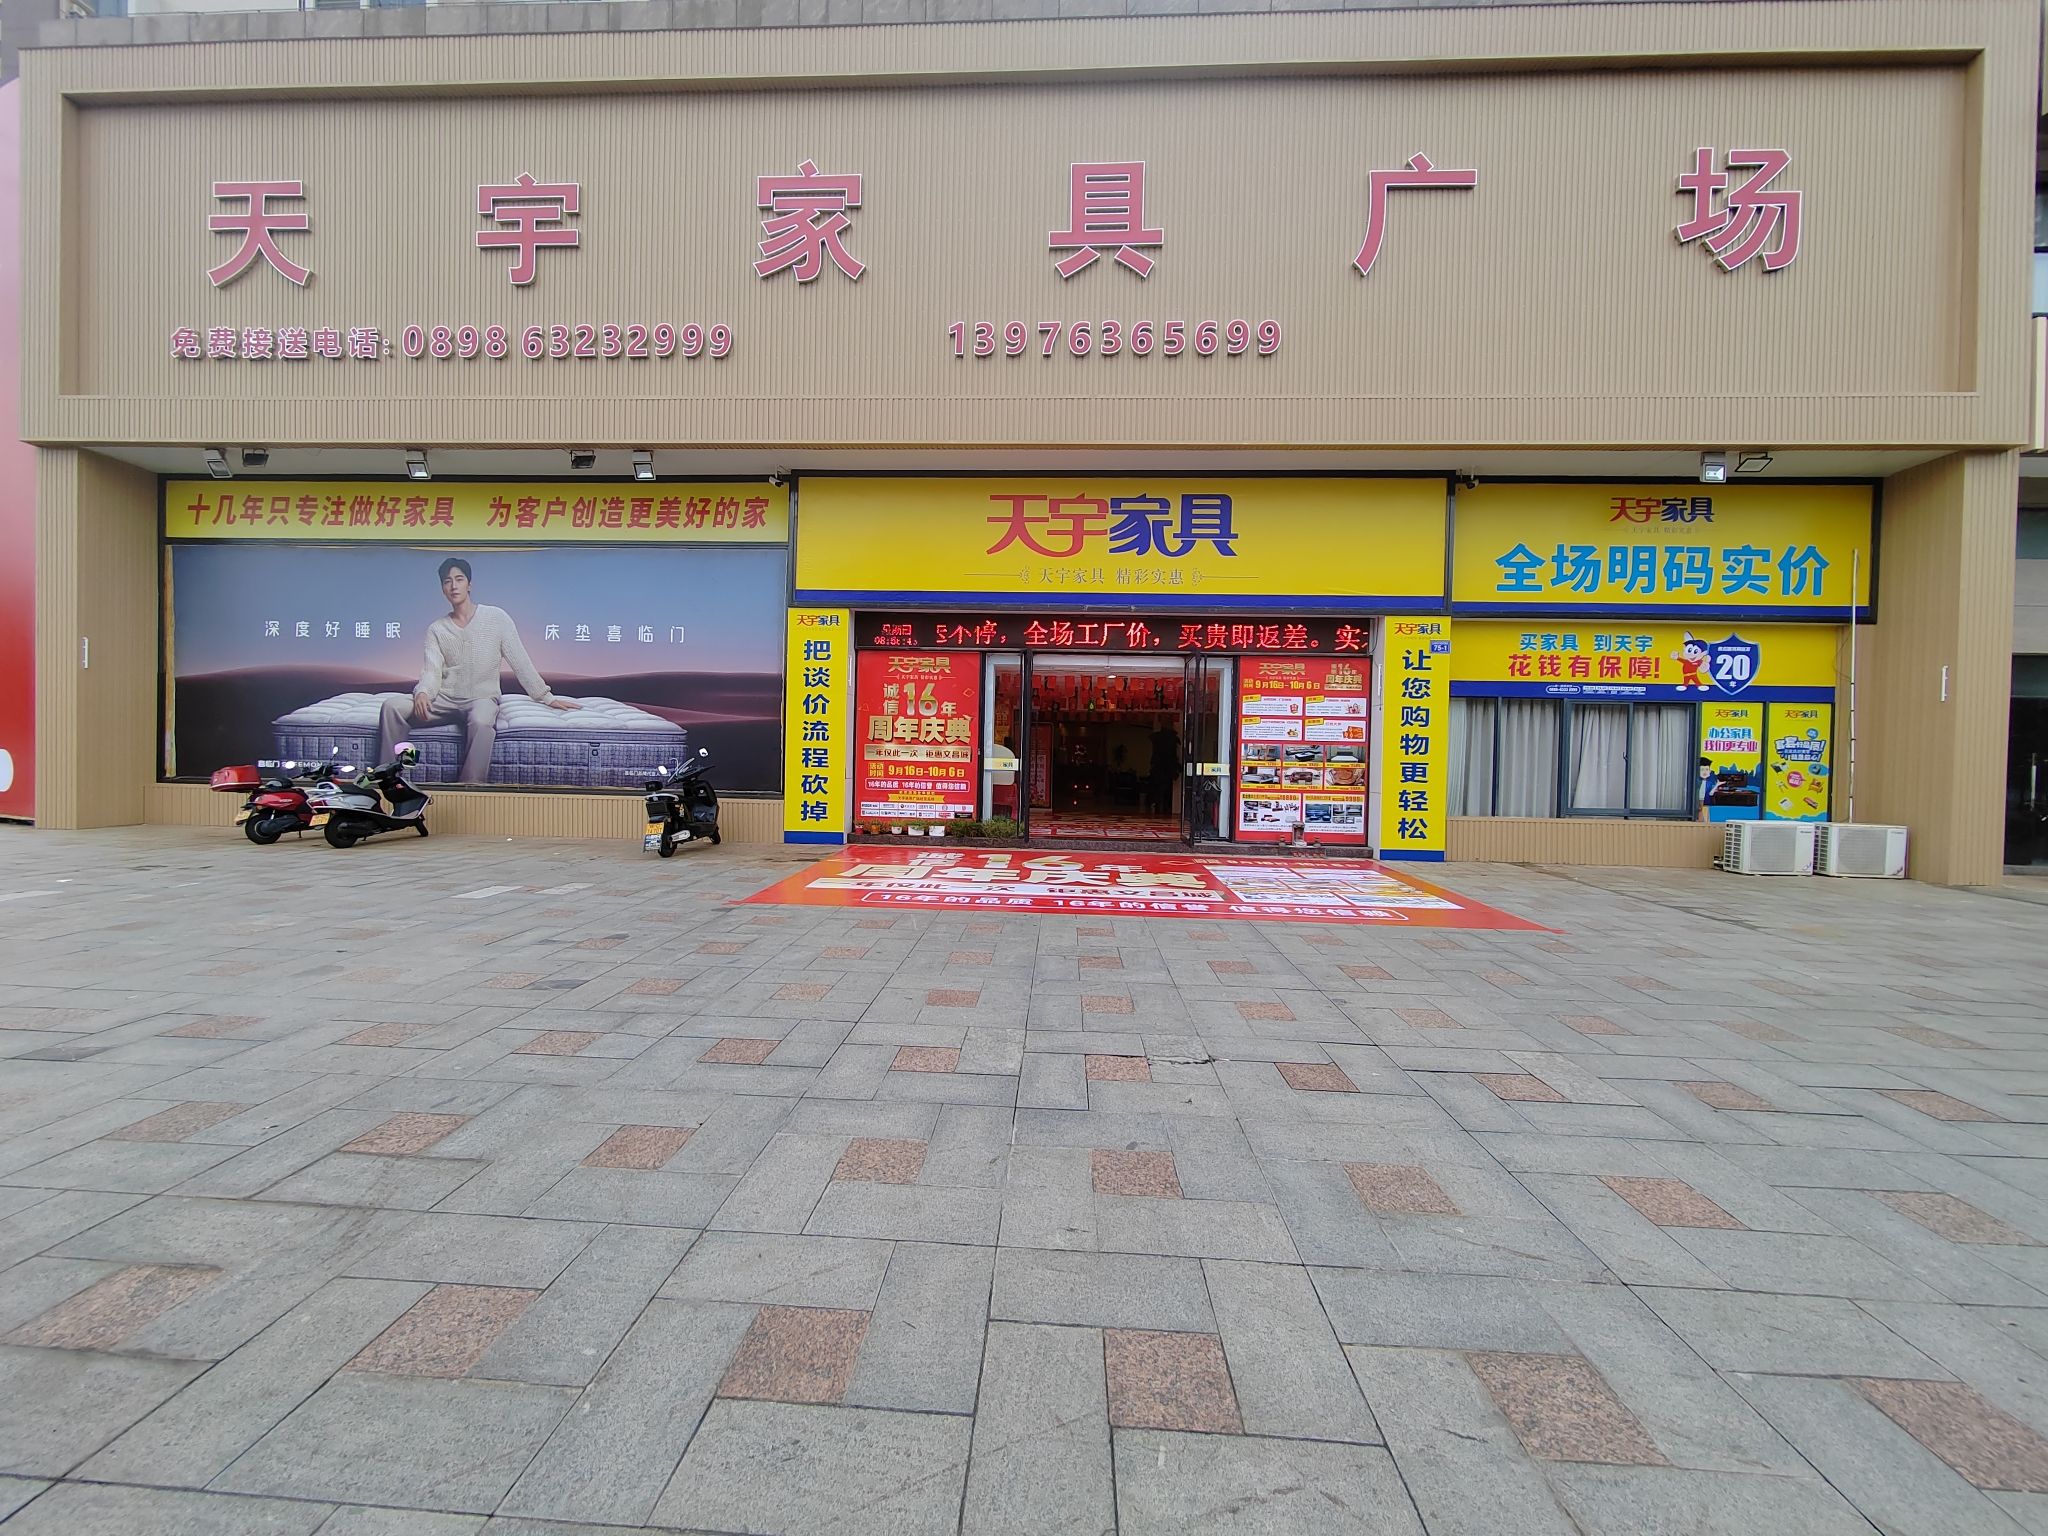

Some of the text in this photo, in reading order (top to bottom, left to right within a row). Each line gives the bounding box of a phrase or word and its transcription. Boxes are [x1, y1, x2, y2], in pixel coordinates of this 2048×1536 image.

[207, 146, 1803, 288] 天宇家具广场
[401, 324, 508, 360] 0898
[521, 323, 732, 360] 63232999
[948, 318, 1281, 356] 13976365699
[187, 493, 770, 529] 十几年只专注做好家具 为客户创造更美好的家
[1609, 496, 1715, 523] 天宇家具
[986, 492, 1239, 558] 天宇家具
[1039, 567, 1184, 585] 天宇家具 精彩实惠
[1494, 542, 1831, 597] 全场明码实价
[264, 620, 401, 639] 深度好睡眠
[544, 623, 685, 643] 床垫喜临门
[796, 614, 840, 626] 天宇家具
[1394, 622, 1442, 635] 天宇家具
[1519, 633, 1654, 653] 买家具 到天宇
[888, 656, 951, 673] 天宇家具
[1715, 654, 1751, 681] 20
[1715, 709, 1749, 718] 天宇家具
[1784, 709, 1819, 719] 天宇家具
[800, 640, 832, 822] 把谈价流程砍掉
[867, 714, 974, 743] 周年庆典
[1397, 649, 1432, 841] 让您购物更轻松
